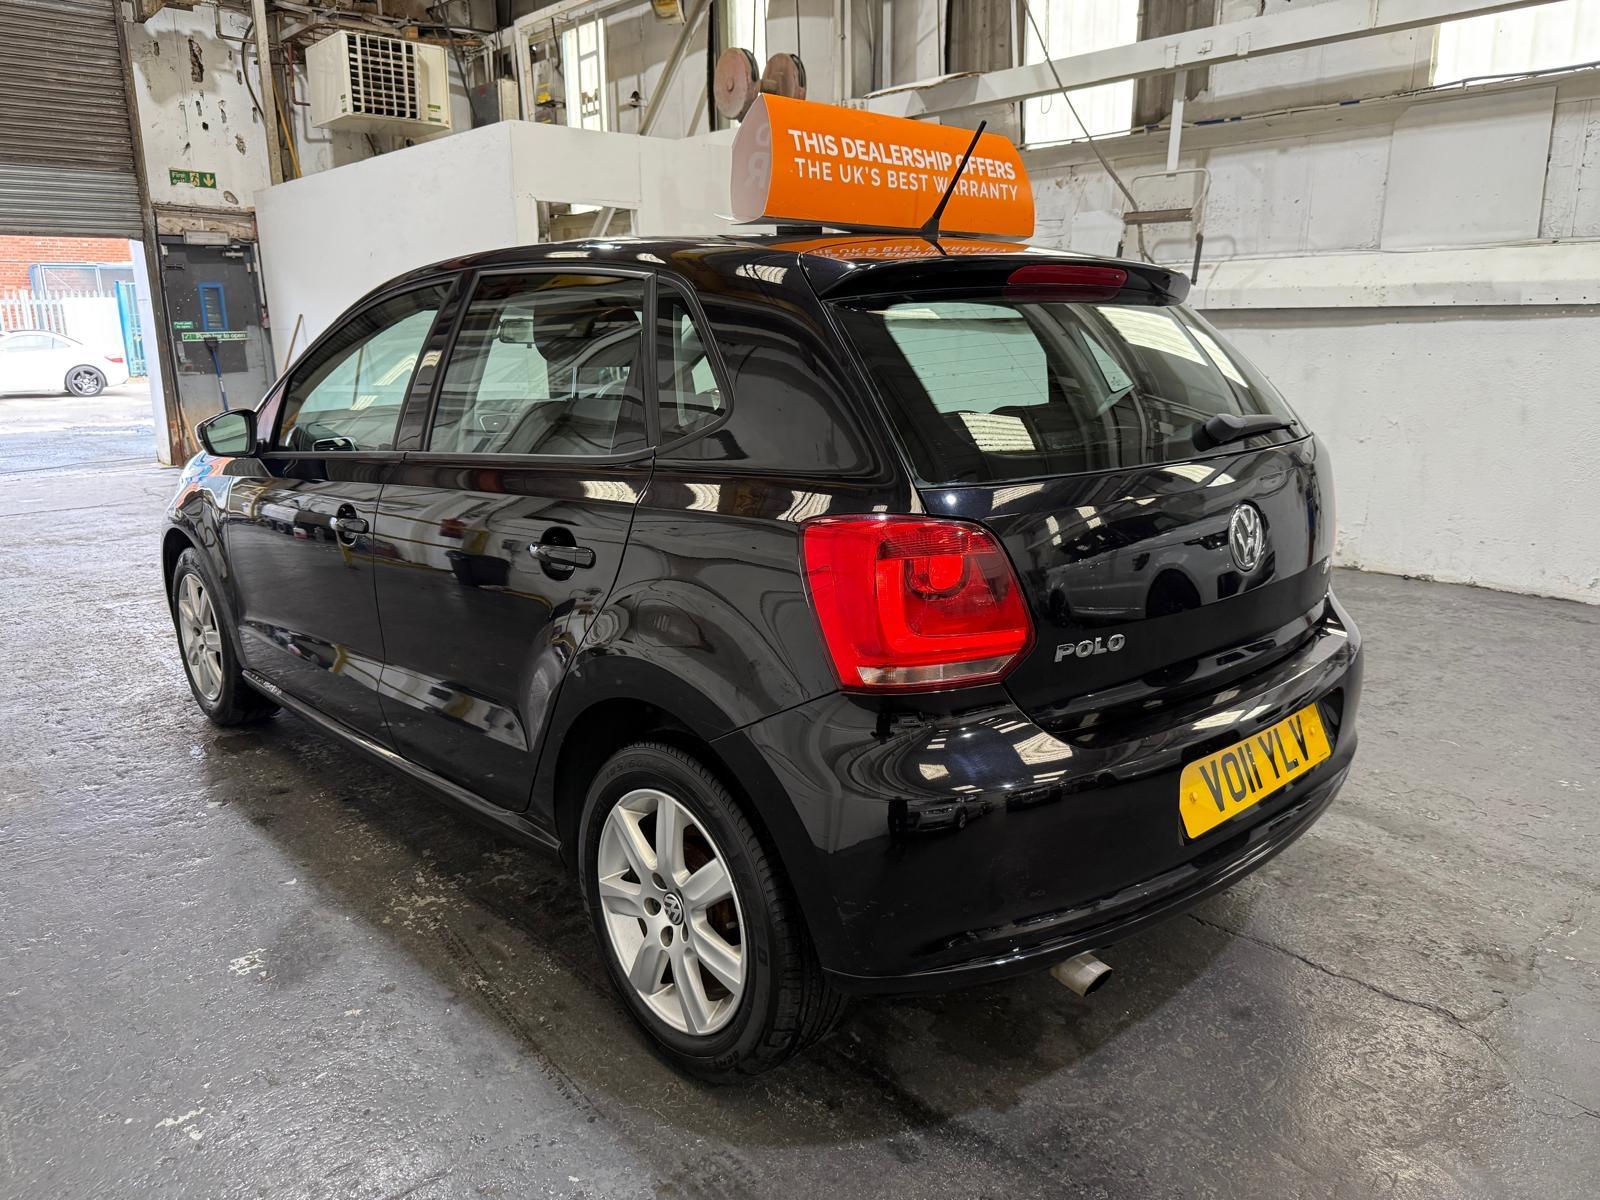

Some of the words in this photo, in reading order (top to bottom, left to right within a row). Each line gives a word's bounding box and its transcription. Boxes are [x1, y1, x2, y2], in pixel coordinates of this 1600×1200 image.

[787, 129, 839, 157] THIS
[841, 137, 952, 172] DEALERSHIP
[794, 157, 833, 181] THE
[840, 165, 881, 187] UK'S
[888, 171, 928, 192] BEST
[1054, 633, 1126, 663] POLO
[1199, 743, 1263, 813] VO11
[1257, 714, 1309, 779] YLV
